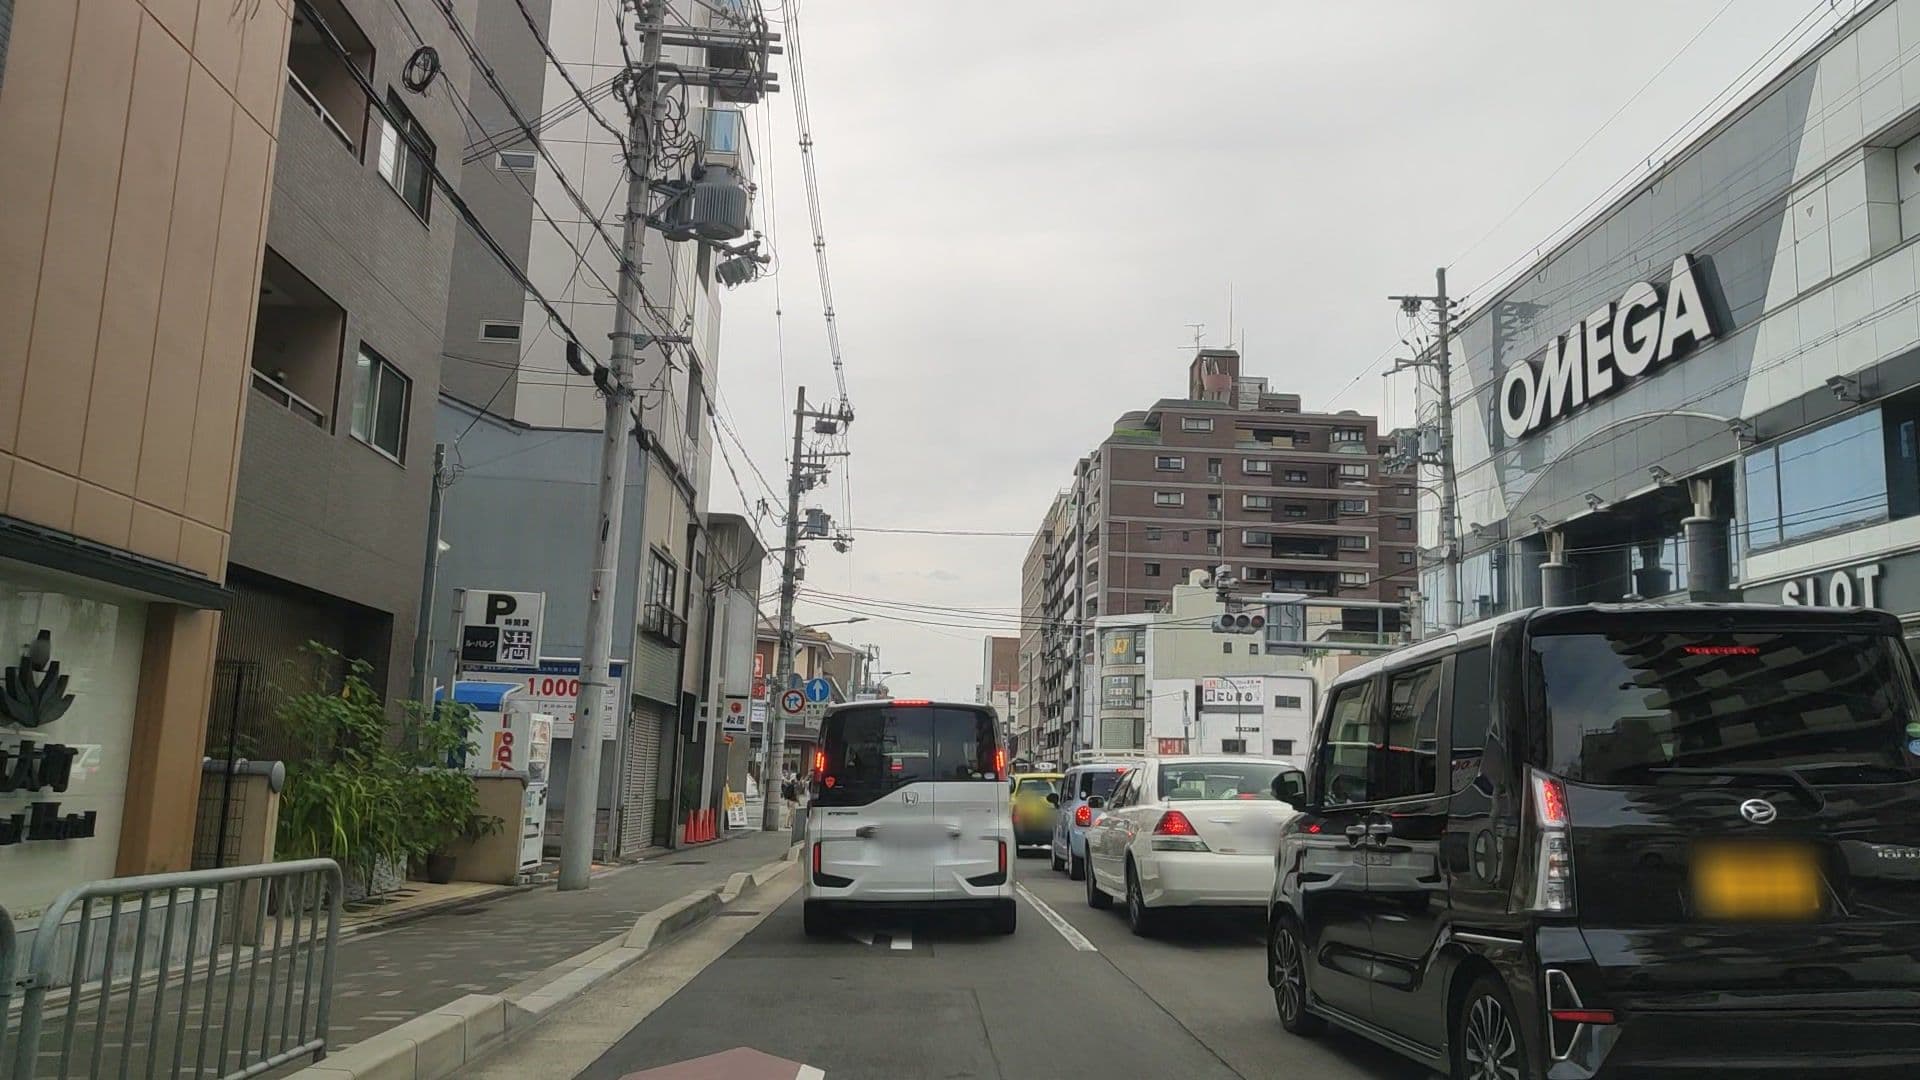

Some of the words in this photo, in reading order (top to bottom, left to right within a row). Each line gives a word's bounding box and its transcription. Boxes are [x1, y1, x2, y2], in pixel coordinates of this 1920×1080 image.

[1500, 253, 1713, 439] OMEGA
[485, 593, 517, 625] P
[502, 631, 532, 661] 満
